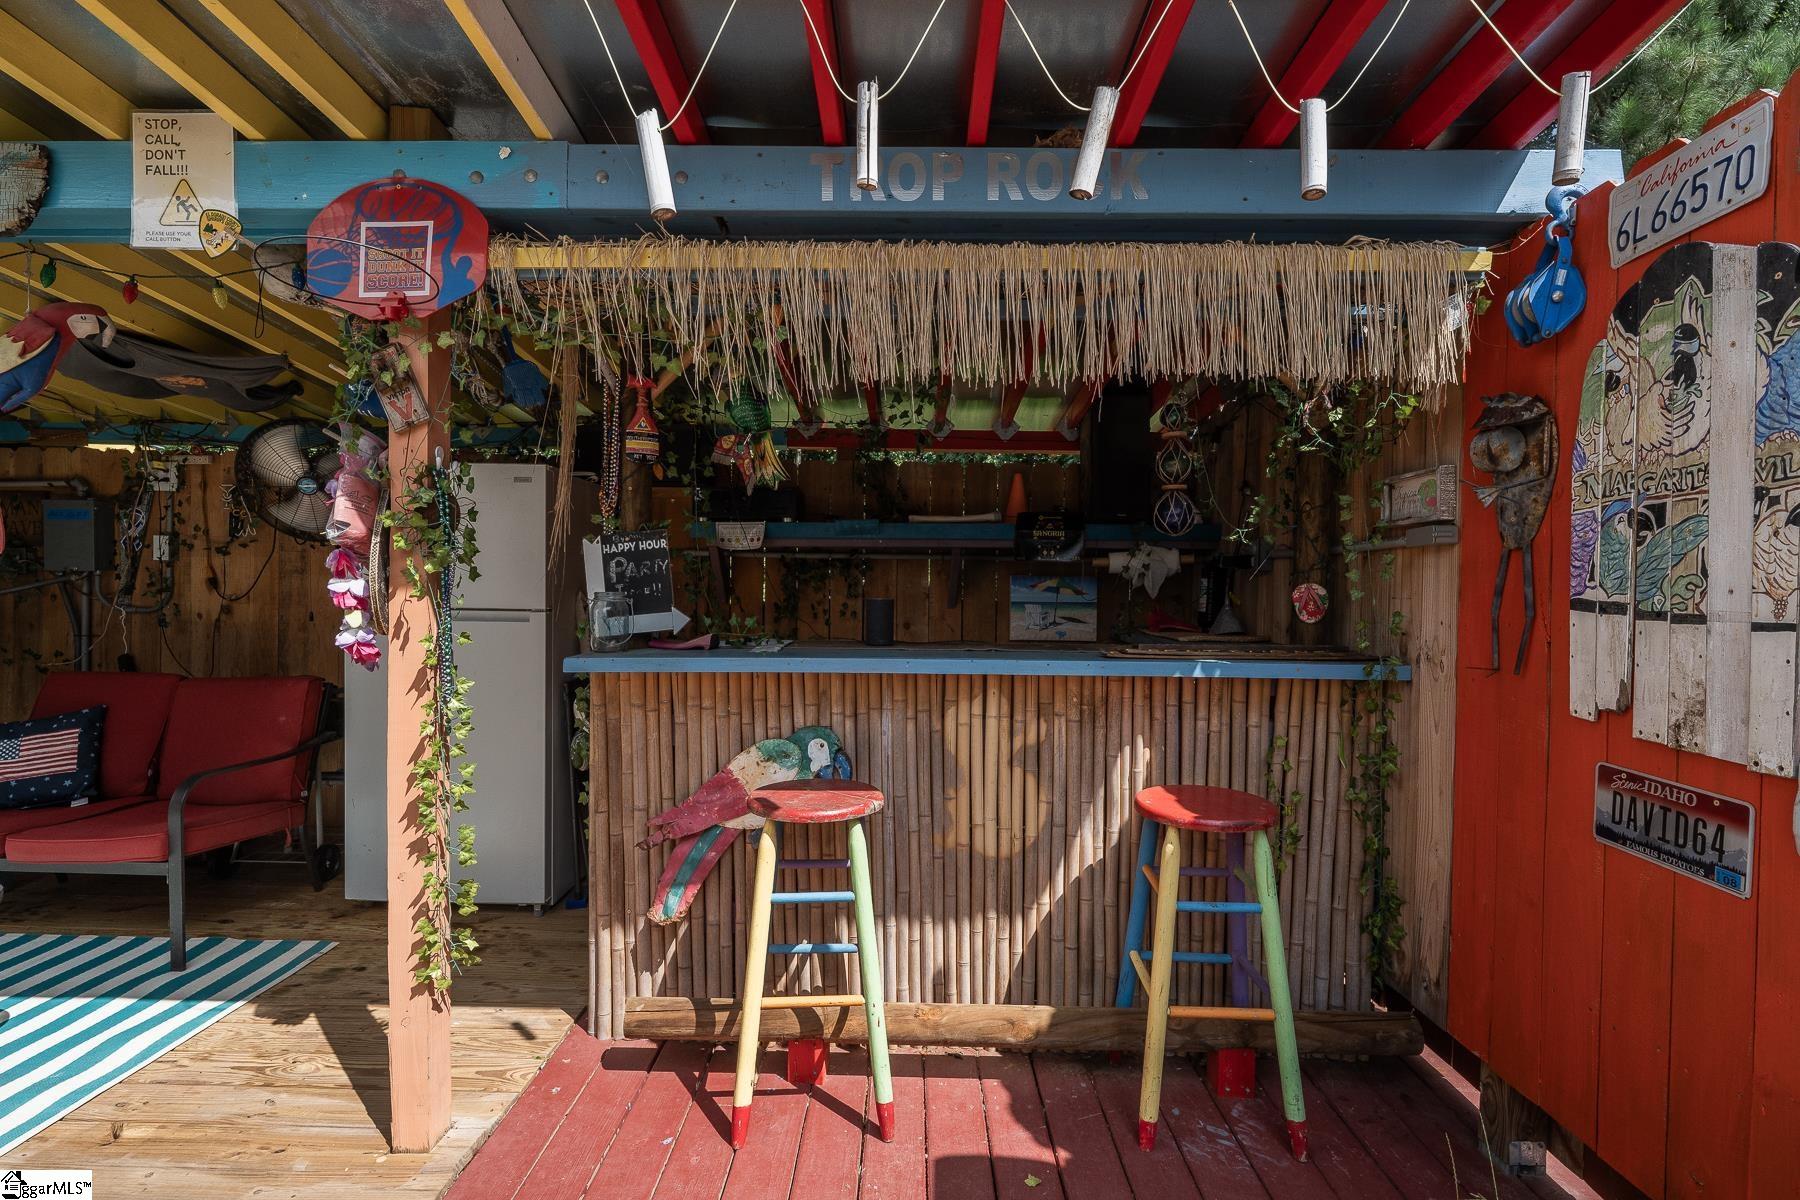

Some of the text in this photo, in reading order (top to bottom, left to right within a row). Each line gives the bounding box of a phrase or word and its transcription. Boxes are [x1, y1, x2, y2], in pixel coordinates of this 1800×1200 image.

[144, 118, 182, 132] STOP,
[144, 134, 181, 146] CALL,
[145, 149, 186, 161] DON'T
[145, 164, 188, 176] FALL!!!
[1640, 137, 1738, 198] California
[987, 151, 1149, 201] ROK
[1616, 144, 1756, 252] 6L66570
[145, 230, 164, 238] PLEASE
[367, 247, 425, 262] SHOOT IT
[367, 261, 407, 274] DUNK
[366, 273, 424, 289] SCORE!
[602, 538, 668, 555] HAPPY HOUR
[609, 556, 669, 584] PARTY
[1611, 773, 1697, 807] Scenic IDAHO
[1611, 790, 1726, 864] DAVID64
[1625, 839, 1705, 877] FAMOUS POTATOES
[1722, 875, 1737, 888] 08
